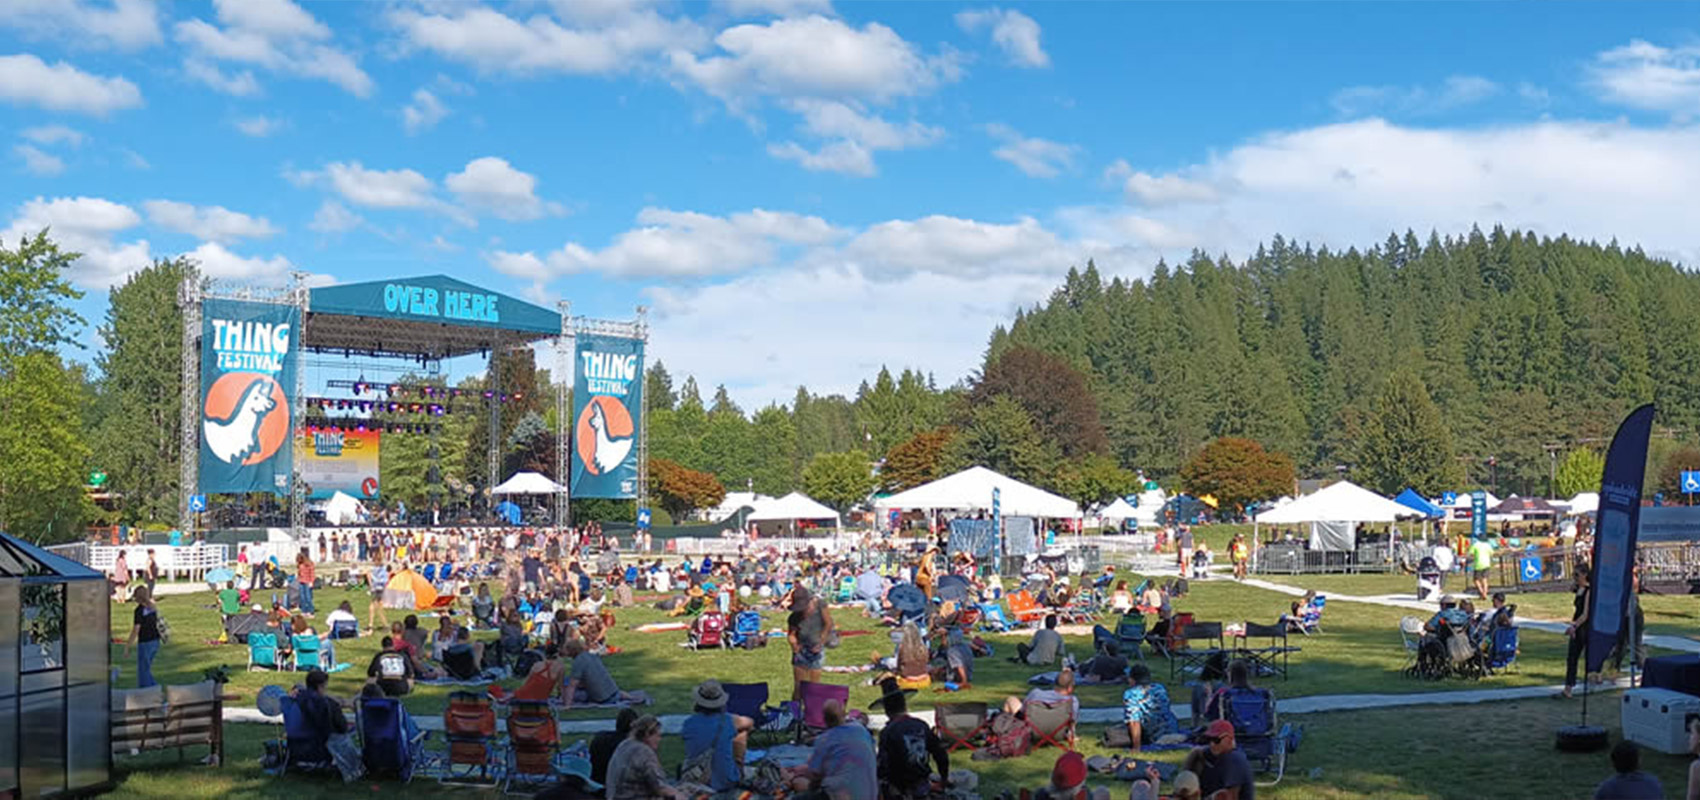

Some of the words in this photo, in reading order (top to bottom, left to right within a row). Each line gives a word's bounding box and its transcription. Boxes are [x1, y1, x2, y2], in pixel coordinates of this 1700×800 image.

[384, 283, 439, 316] OVER
[444, 290, 499, 322] HERE
[212, 319, 290, 354] THING
[217, 353, 282, 370] FESTIVAL
[581, 350, 637, 380] THING
